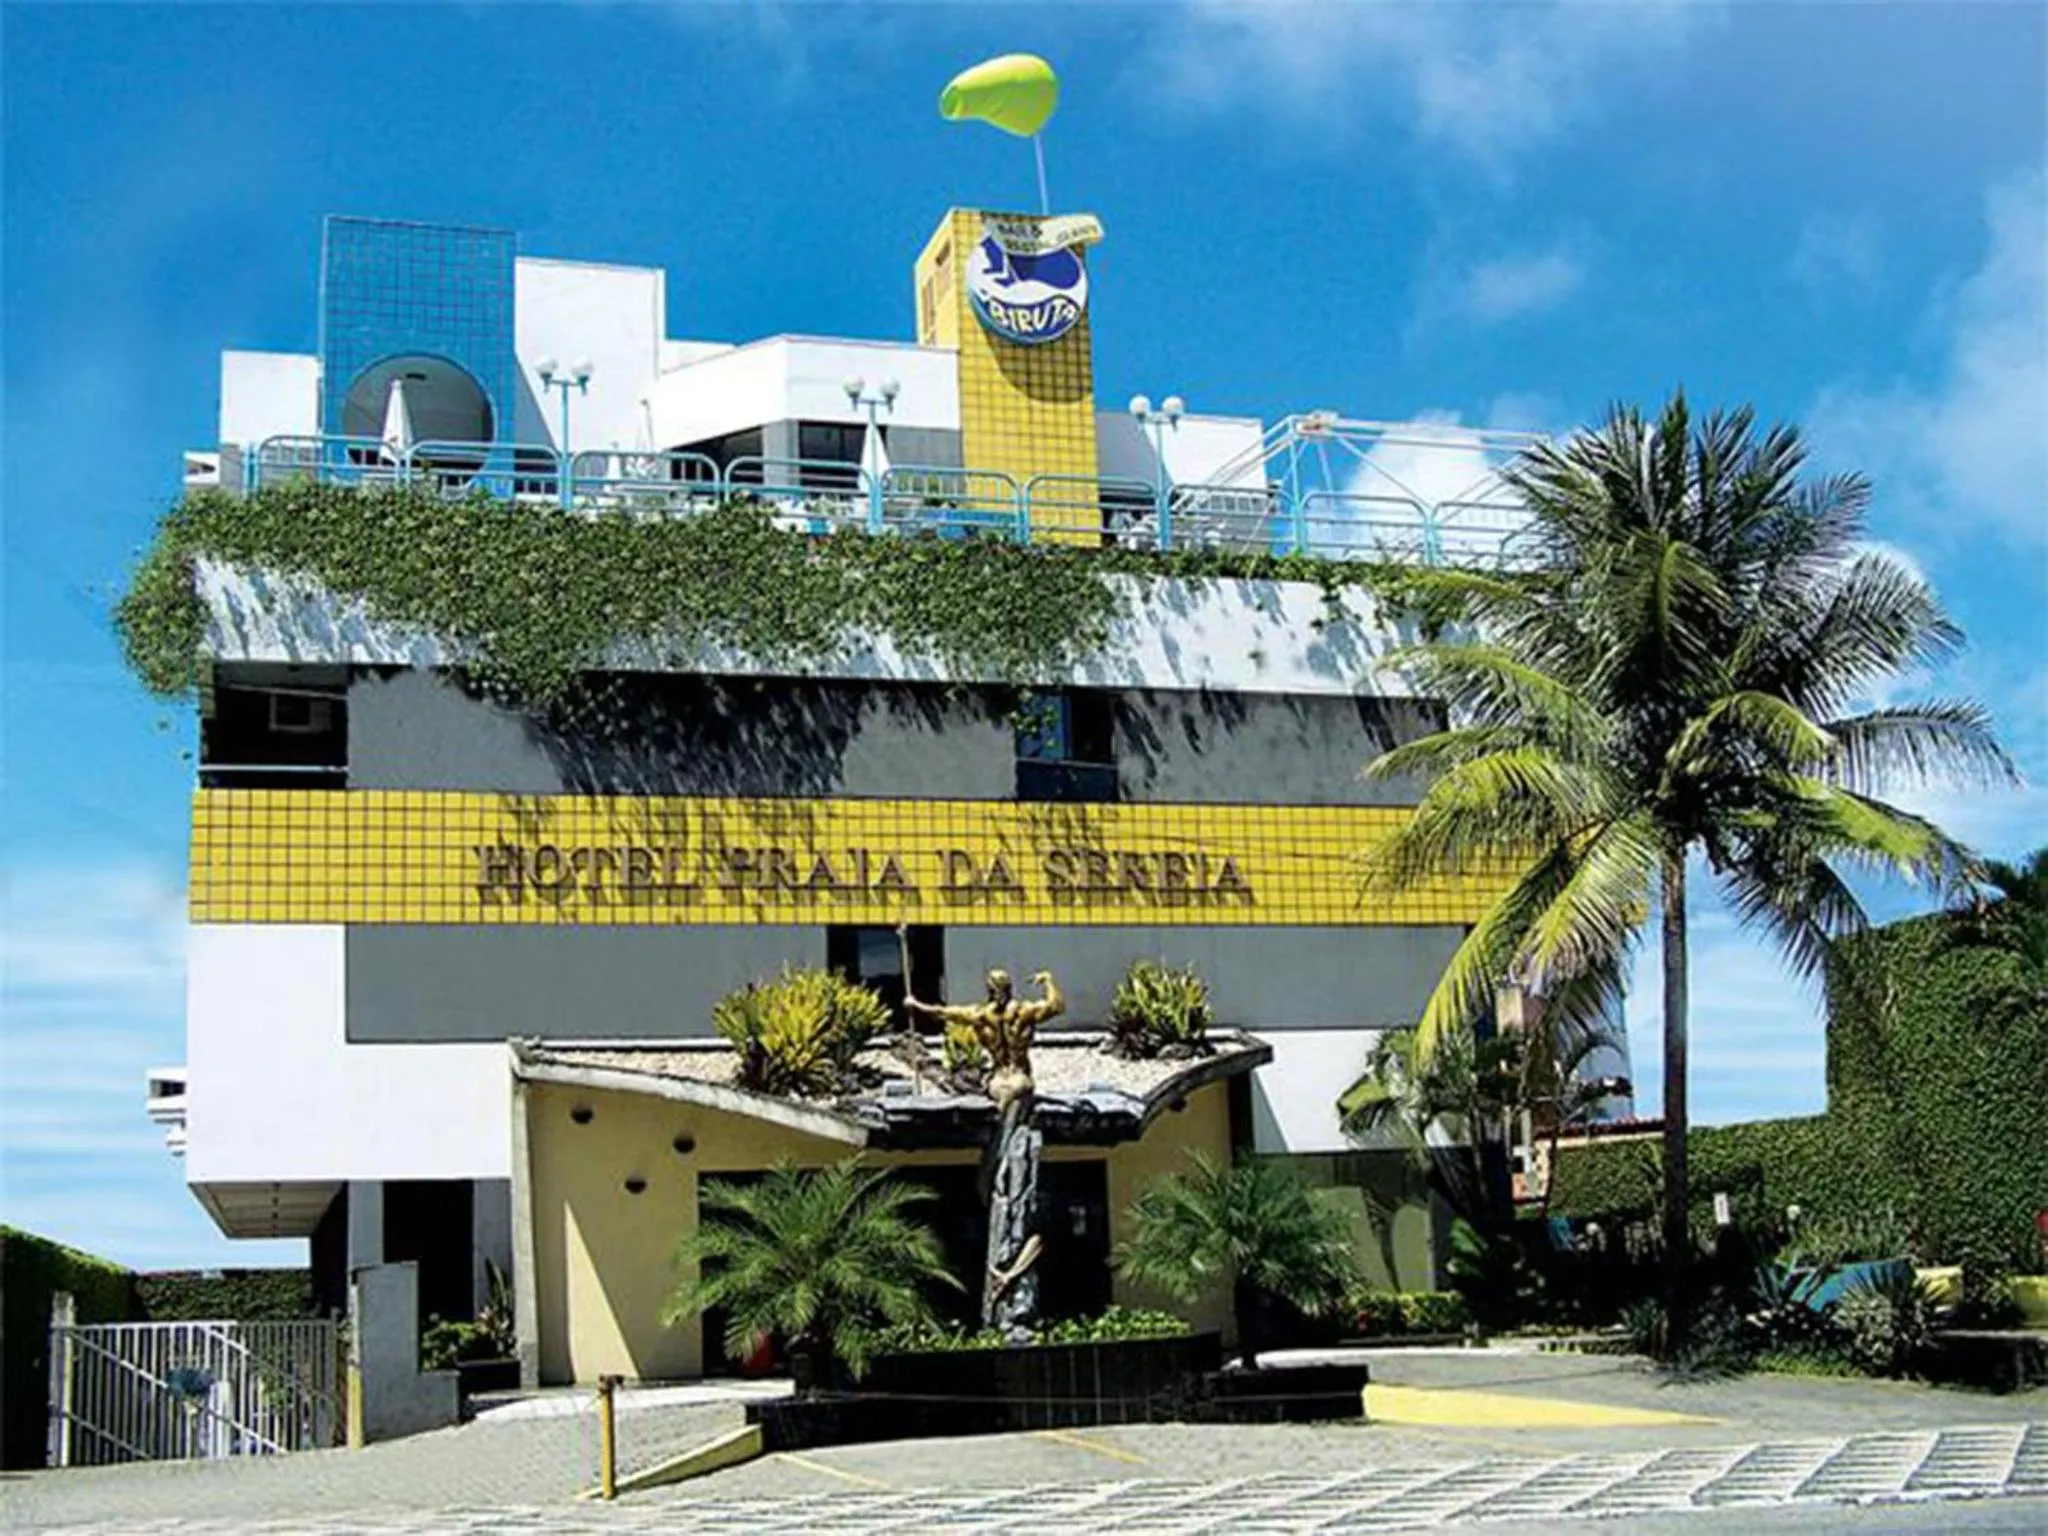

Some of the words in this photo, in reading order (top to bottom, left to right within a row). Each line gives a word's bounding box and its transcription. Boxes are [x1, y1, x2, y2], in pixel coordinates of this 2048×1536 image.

[474, 844, 698, 888] HOTEL
[716, 847, 918, 889] PRAIA
[938, 849, 1026, 890] DA
[1045, 850, 1254, 891] SEREIA
